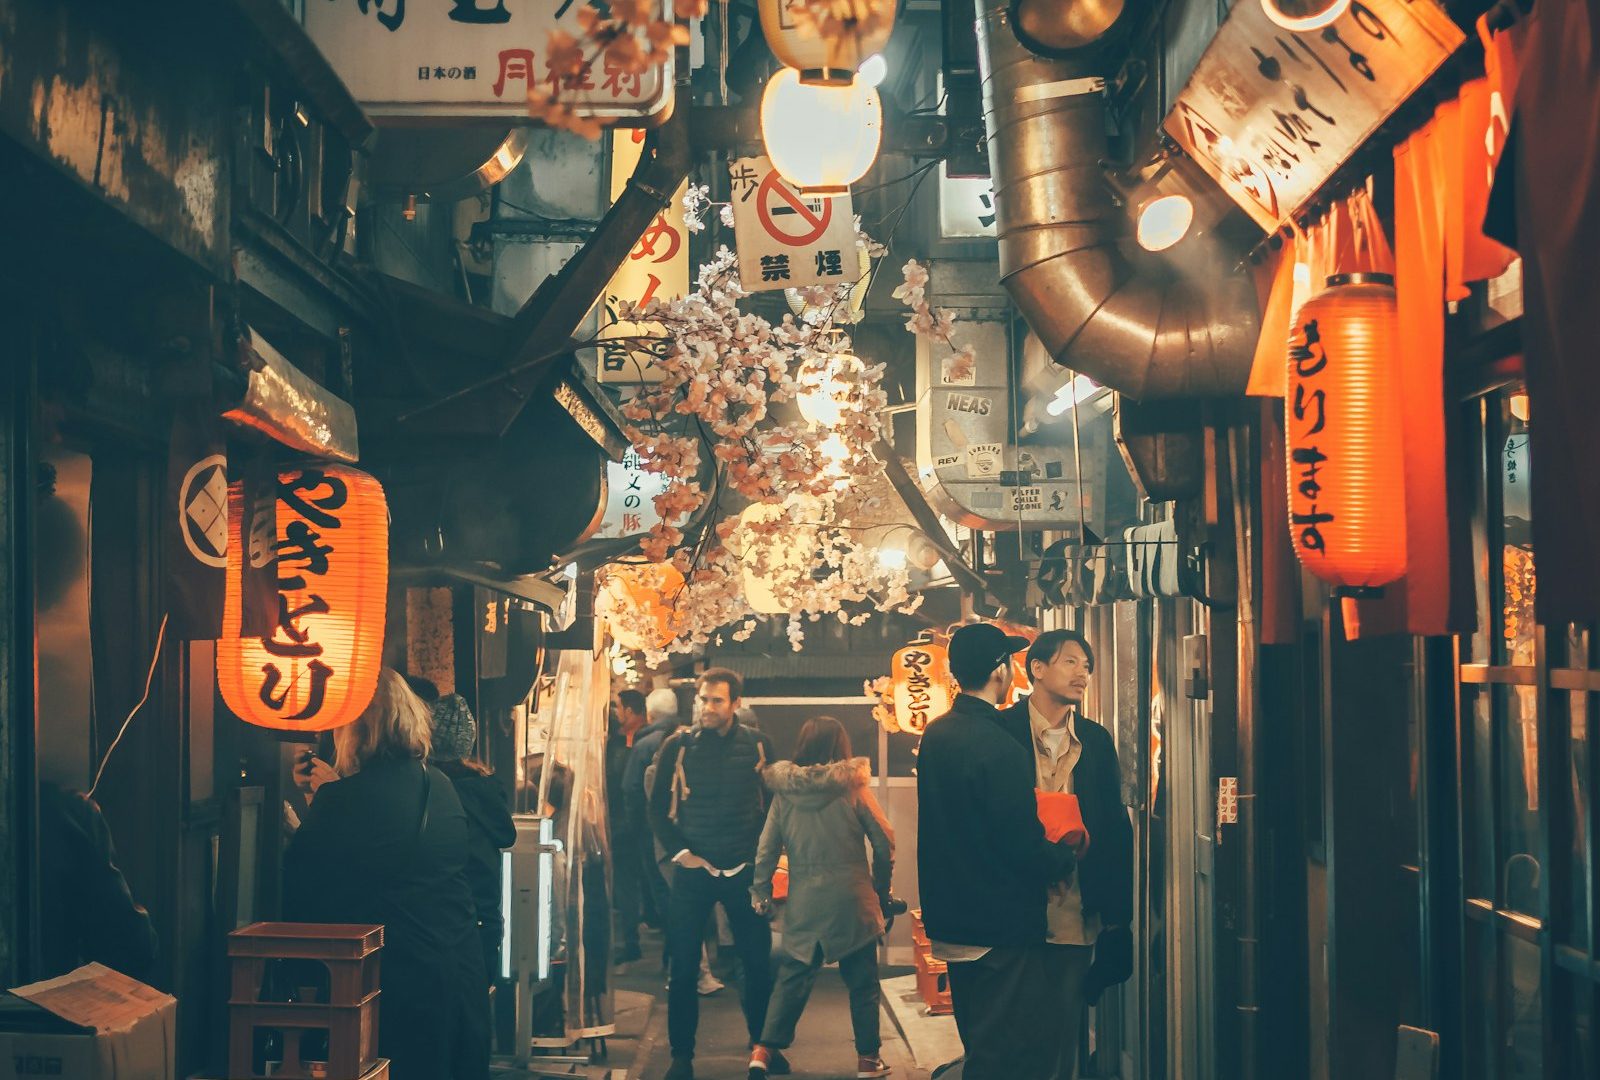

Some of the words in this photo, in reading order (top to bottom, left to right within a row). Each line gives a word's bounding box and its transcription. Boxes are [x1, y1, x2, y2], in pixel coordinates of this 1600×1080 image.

[418, 65, 477, 81] 日本の酒
[760, 250, 843, 281] 禁煙
[947, 394, 991, 415] NEAS
[937, 456, 959, 466] REV
[259, 470, 348, 720] やきとり
[904, 651, 931, 731] やきとり
